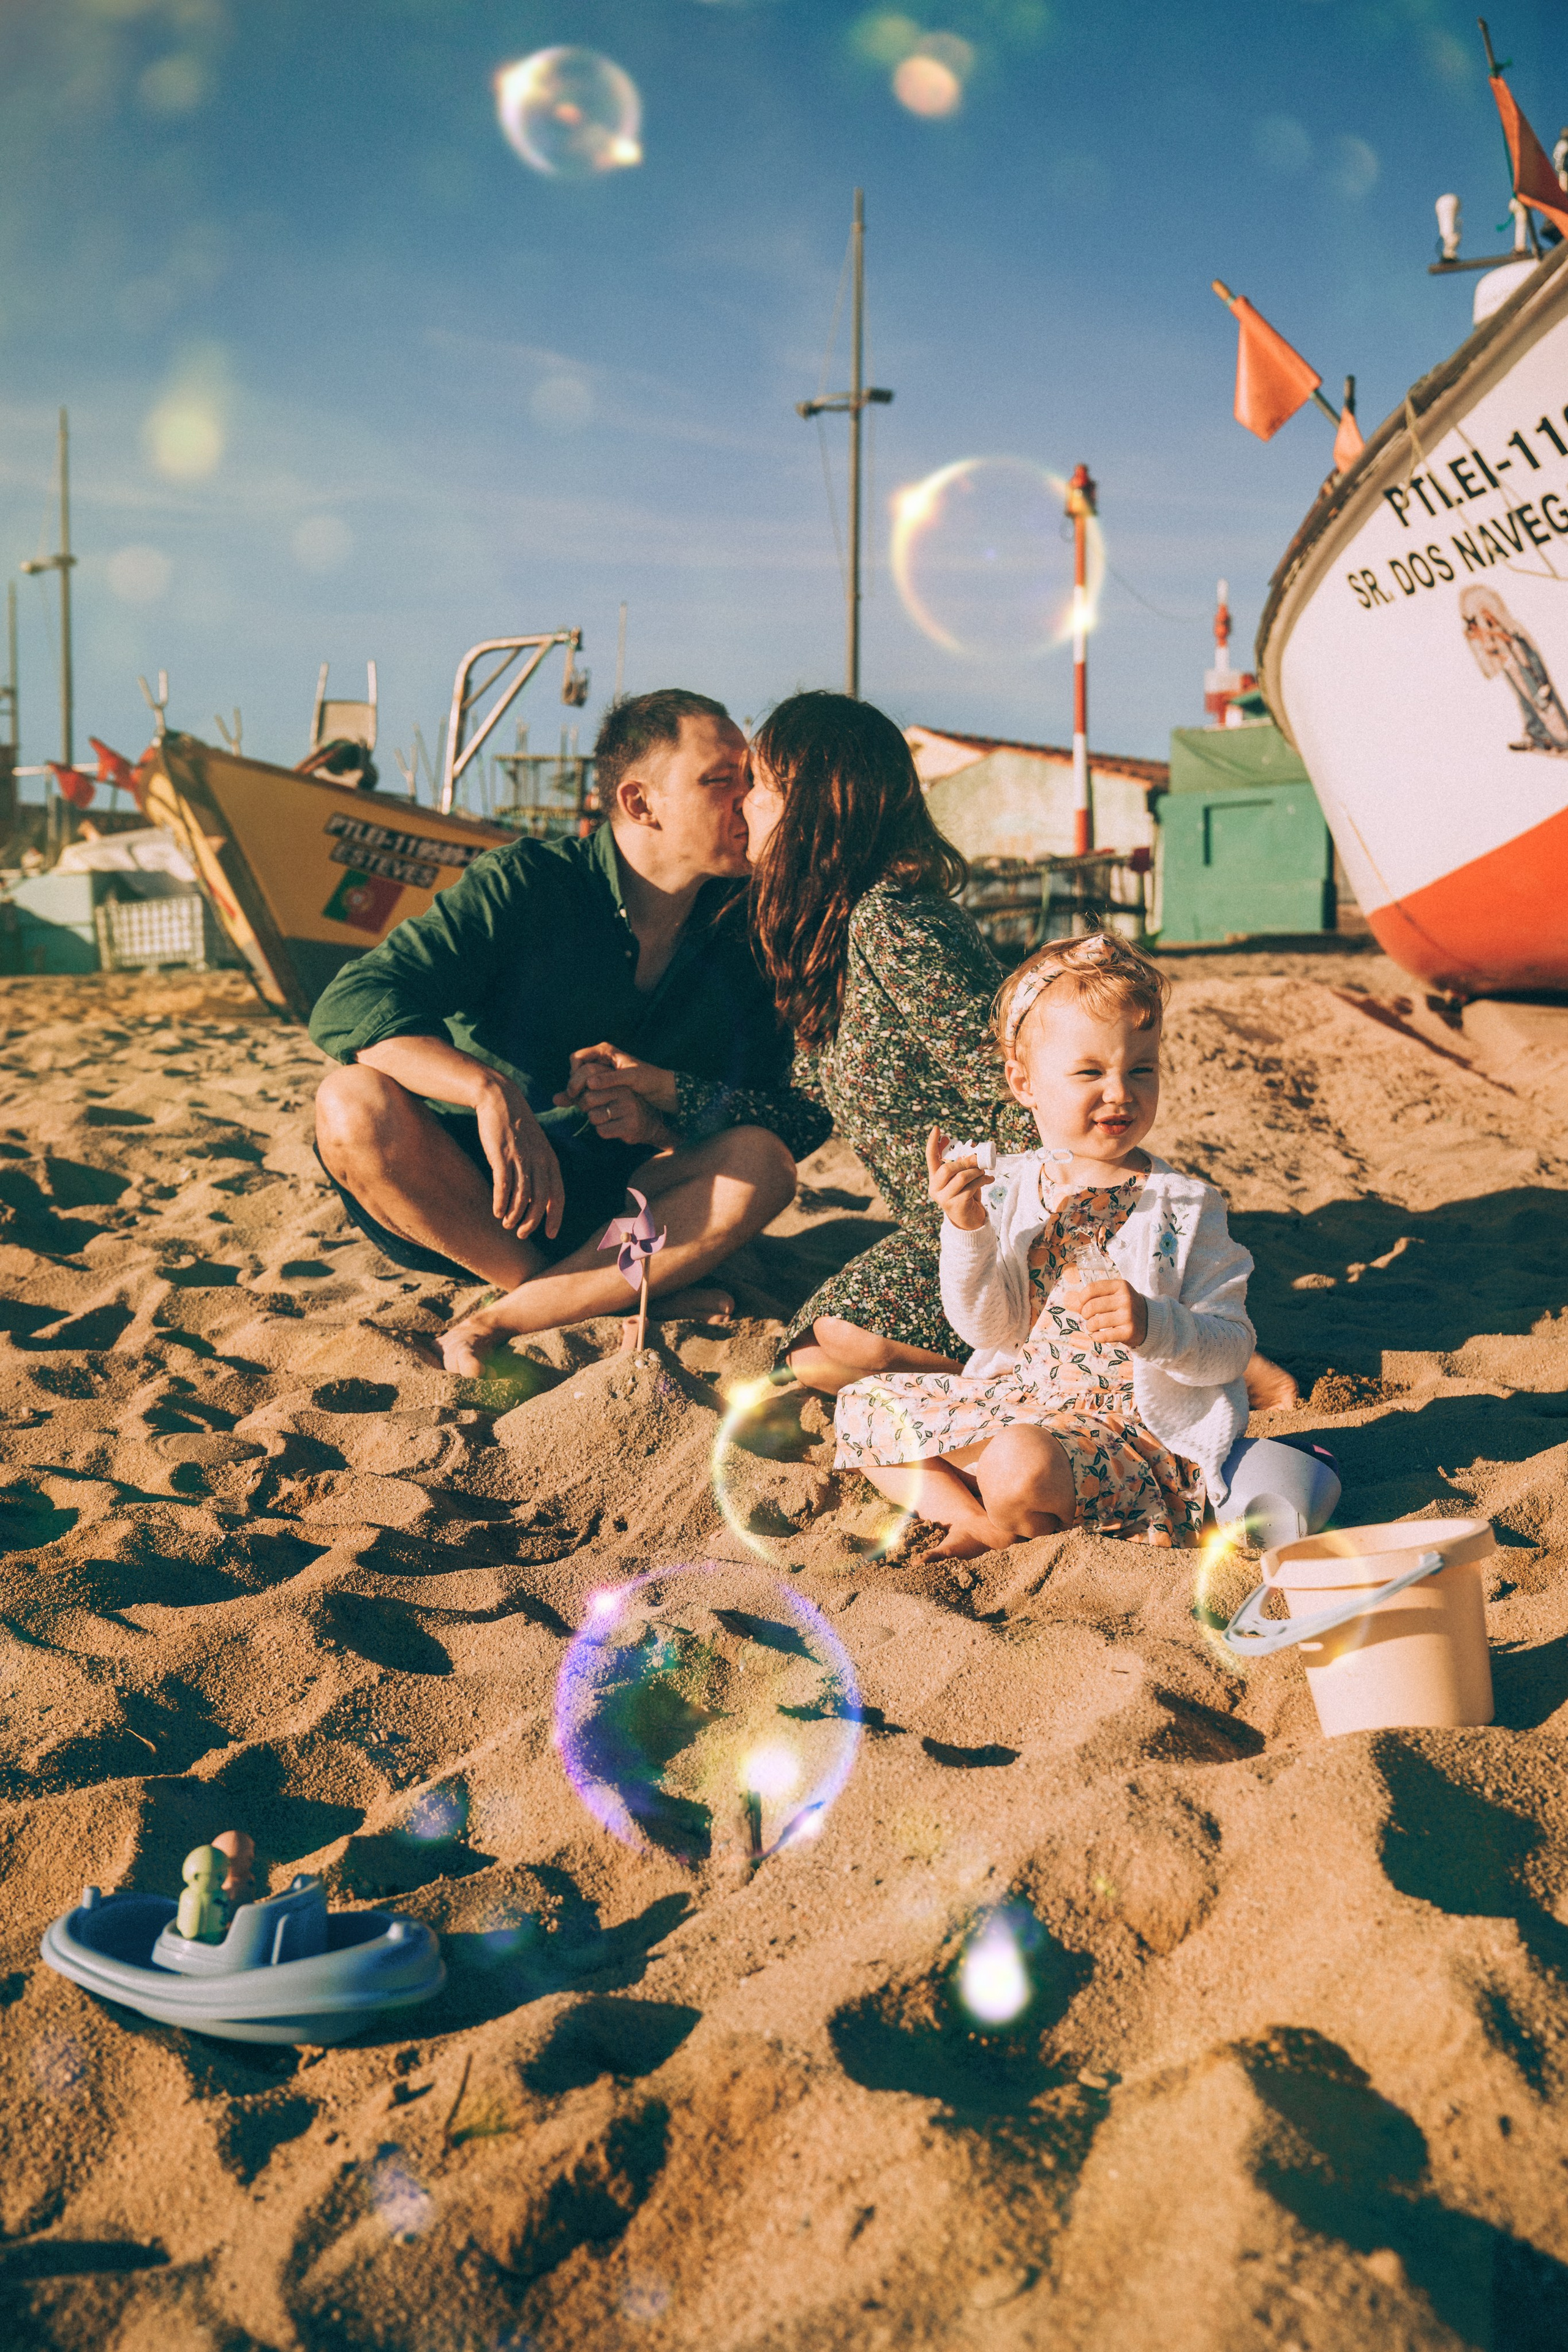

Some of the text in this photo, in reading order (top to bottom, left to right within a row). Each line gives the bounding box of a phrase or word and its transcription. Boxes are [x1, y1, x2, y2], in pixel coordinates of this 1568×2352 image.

[1383, 404, 1568, 527] PTLEI-11
[1348, 569, 1395, 609] SR.
[1389, 545, 1455, 595] DOS
